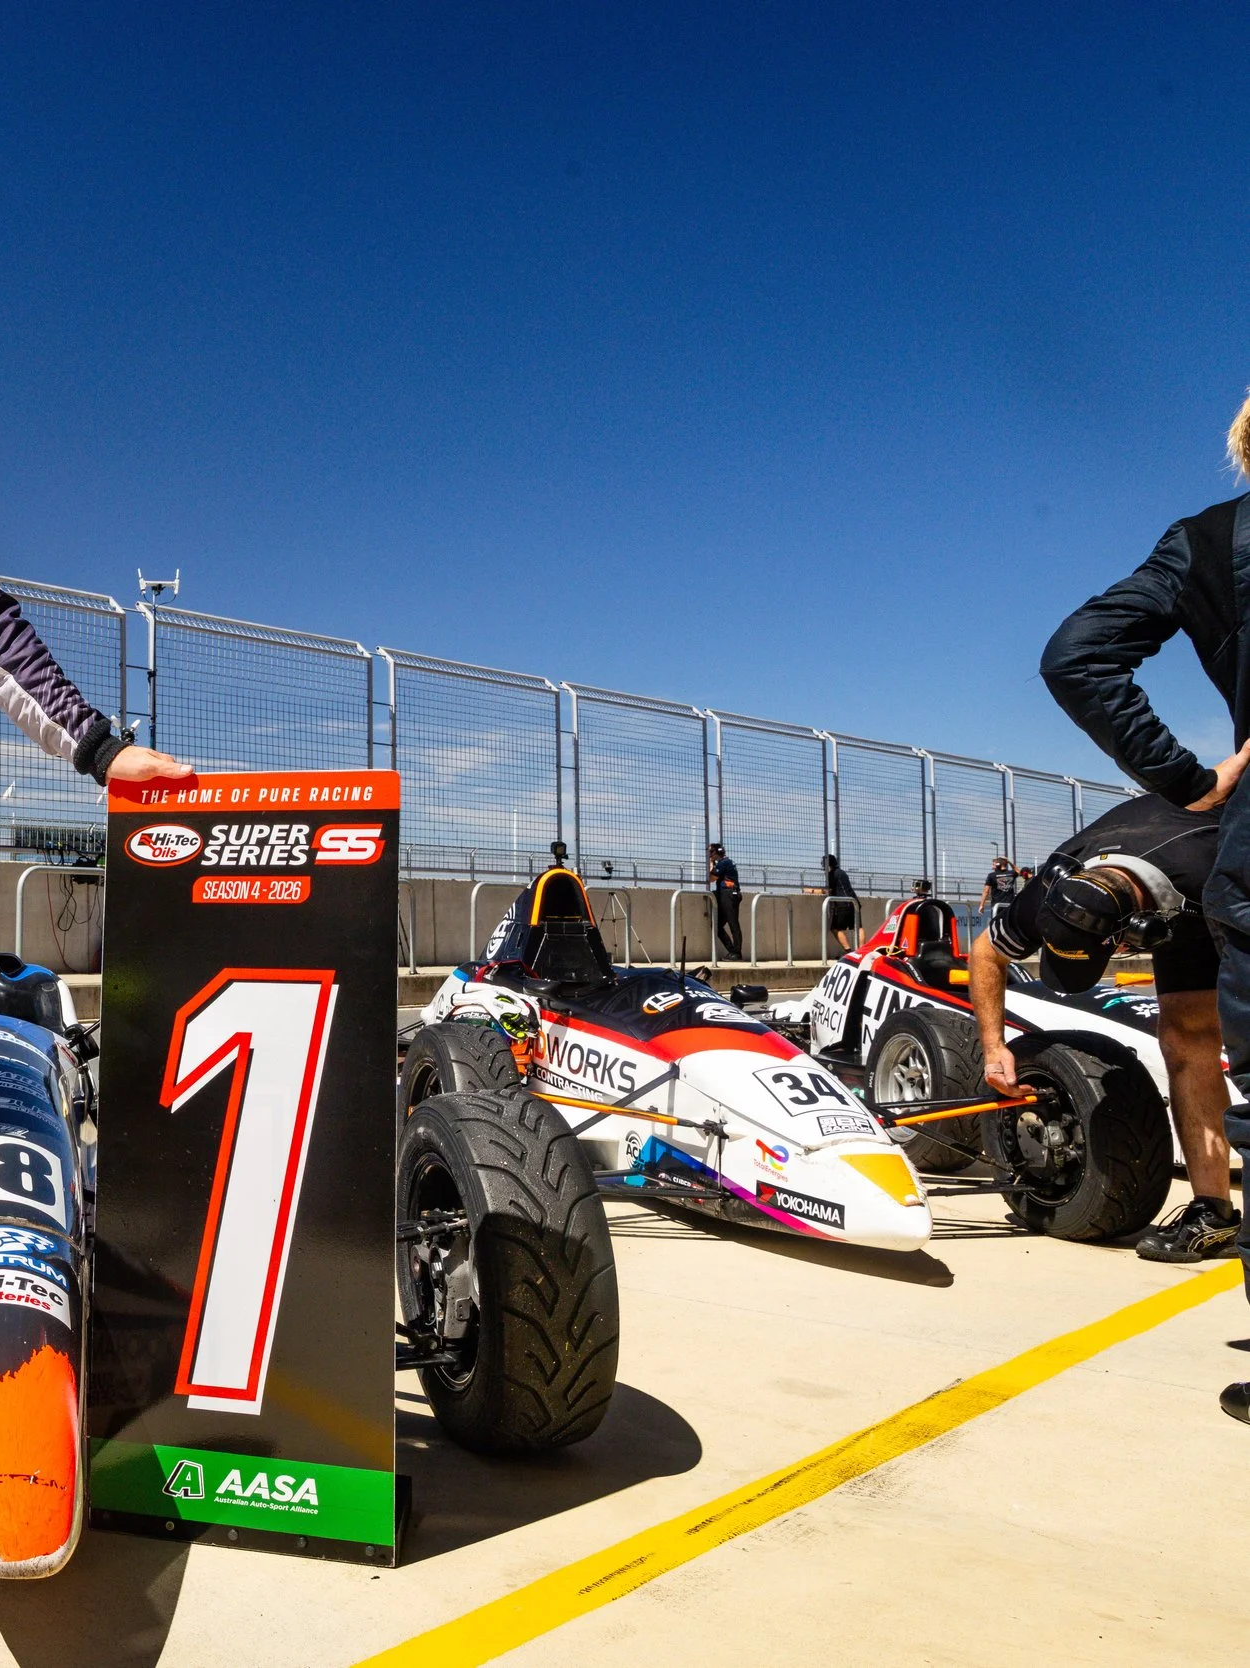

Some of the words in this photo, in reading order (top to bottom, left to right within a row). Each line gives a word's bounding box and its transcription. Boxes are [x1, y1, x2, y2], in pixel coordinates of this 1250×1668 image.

[141, 789, 169, 804] THE
[177, 788, 224, 804] HOME
[231, 788, 250, 803] OF
[258, 787, 300, 803] PURE
[309, 786, 373, 802] RACING
[152, 832, 199, 847] Hi-Tec
[209, 824, 310, 845] SUPER
[151, 846, 178, 859] Oils
[201, 845, 310, 866] SERIES
[202, 881, 250, 900] SEASON
[250, 881, 260, 900] 4
[268, 880, 302, 900] 2026
[956, 916, 987, 927] HYUDAI
[536, 1067, 604, 1102] CONTRACTING
[771, 1072, 851, 1106] 34
[753, 1158, 789, 1183] TotalEnergies
[158, 967, 340, 1416] 1
[775, 1191, 842, 1225] YOKOHAMA
[215, 1469, 319, 1506] AASA
[213, 1496, 249, 1506] Australian
[249, 1500, 289, 1512] Auto-Sport
[289, 1505, 319, 1515] Alliance
